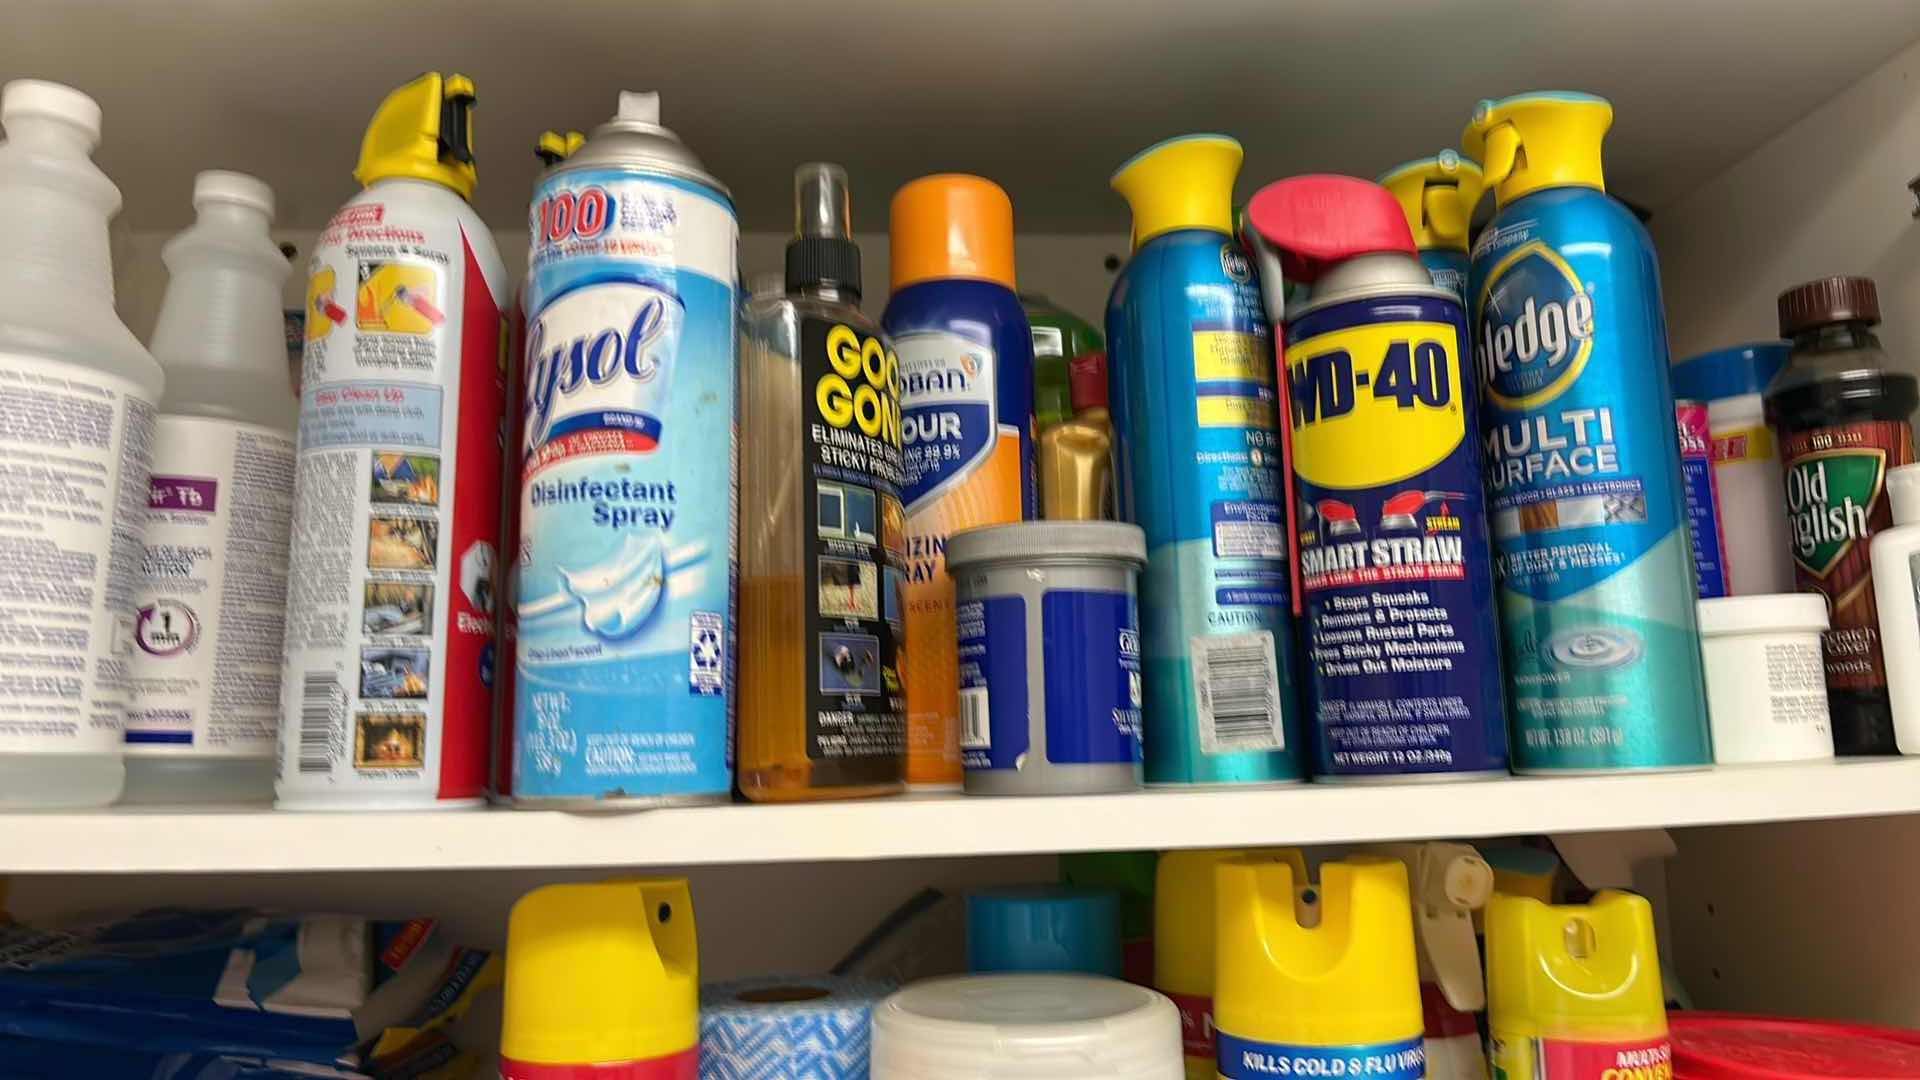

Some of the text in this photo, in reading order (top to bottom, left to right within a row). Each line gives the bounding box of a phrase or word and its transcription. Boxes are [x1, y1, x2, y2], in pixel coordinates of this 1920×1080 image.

[540, 184, 609, 246] 100
[1286, 338, 1452, 432] WD-40
[901, 411, 963, 443] OUR
[1484, 408, 1613, 462] MULTI
[811, 424, 884, 459] ELIMINATES
[925, 443, 961, 460] 99.9%
[1811, 433, 1833, 450] 100
[821, 447, 868, 472] STICKY
[1486, 445, 1620, 491] URFACE
[176, 486, 203, 506] Tb
[531, 477, 677, 507] Disinfectant
[1787, 461, 1829, 515] Old
[592, 502, 675, 531] Spray
[1789, 496, 1869, 559] nglish
[905, 535, 948, 560] IZIN
[1301, 541, 1368, 578] SMART
[1371, 535, 1464, 567] STRAW
[1550, 541, 1613, 557] REMOVAL
[1358, 569, 1379, 582] THE
[1383, 566, 1424, 580] STRAW
[1333, 589, 1430, 612] Stops Squeaks
[1208, 610, 1263, 627] CAUTION
[1375, 608, 1386, 623] &
[1389, 606, 1448, 622] Protects
[1366, 623, 1414, 640] Rusted
[1417, 623, 1454, 638] Parts
[1342, 643, 1382, 661] Sticky
[1384, 638, 1465, 657] Mechanisms
[1362, 658, 1389, 674] Out
[1391, 655, 1453, 673] Moisture
[1351, 751, 1390, 767] WEIGHT
[1242, 1050, 1291, 1076] KILLS
[1293, 1057, 1346, 1077] COLD
[1348, 1056, 1362, 1076] &
[1364, 1053, 1397, 1075] FLU
